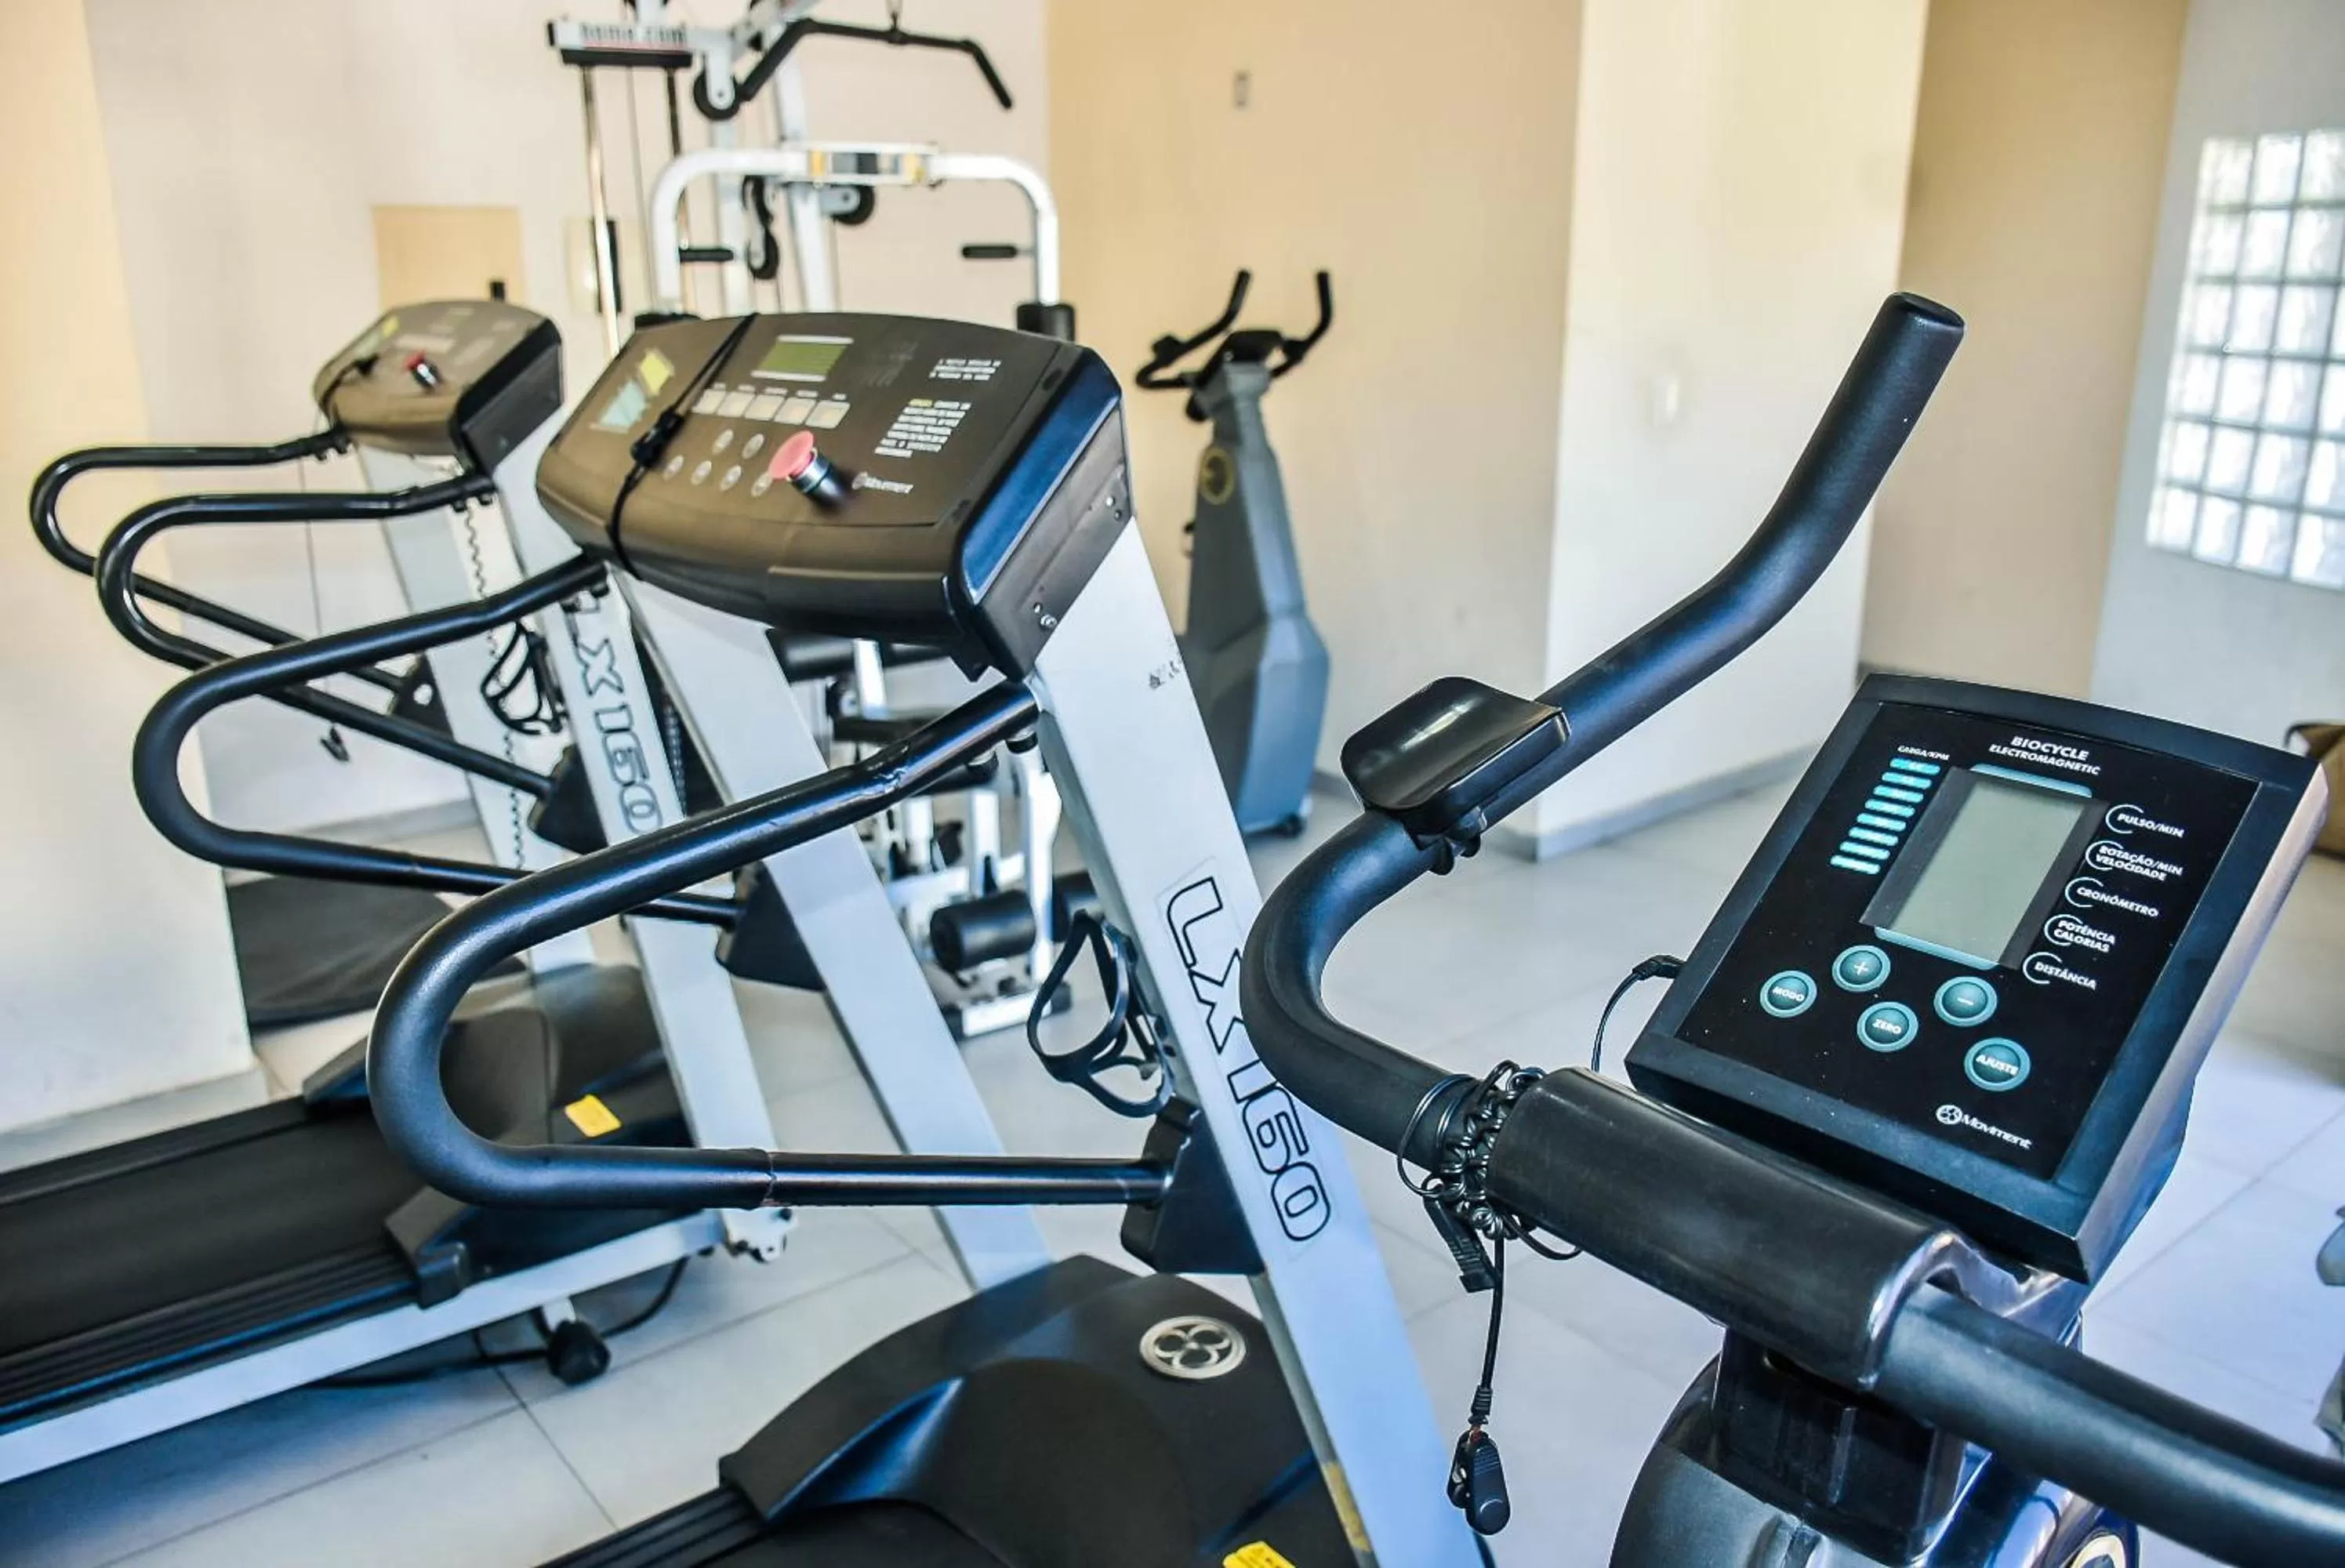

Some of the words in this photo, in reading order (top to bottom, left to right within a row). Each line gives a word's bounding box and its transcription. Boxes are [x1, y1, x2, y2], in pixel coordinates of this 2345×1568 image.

[1988, 744, 2101, 775] ELECTROMAGNETIC
[2010, 735, 2089, 761] BIOCYCLE
[2117, 813, 2185, 837] PULSO/MIN
[2096, 854, 2167, 881] VELOCIDADE
[2053, 928, 2110, 953] CALORIAS
[1772, 985, 1805, 1003] MODO
[1872, 1018, 1902, 1034] ZERO
[1167, 877, 1331, 1241] LX160
